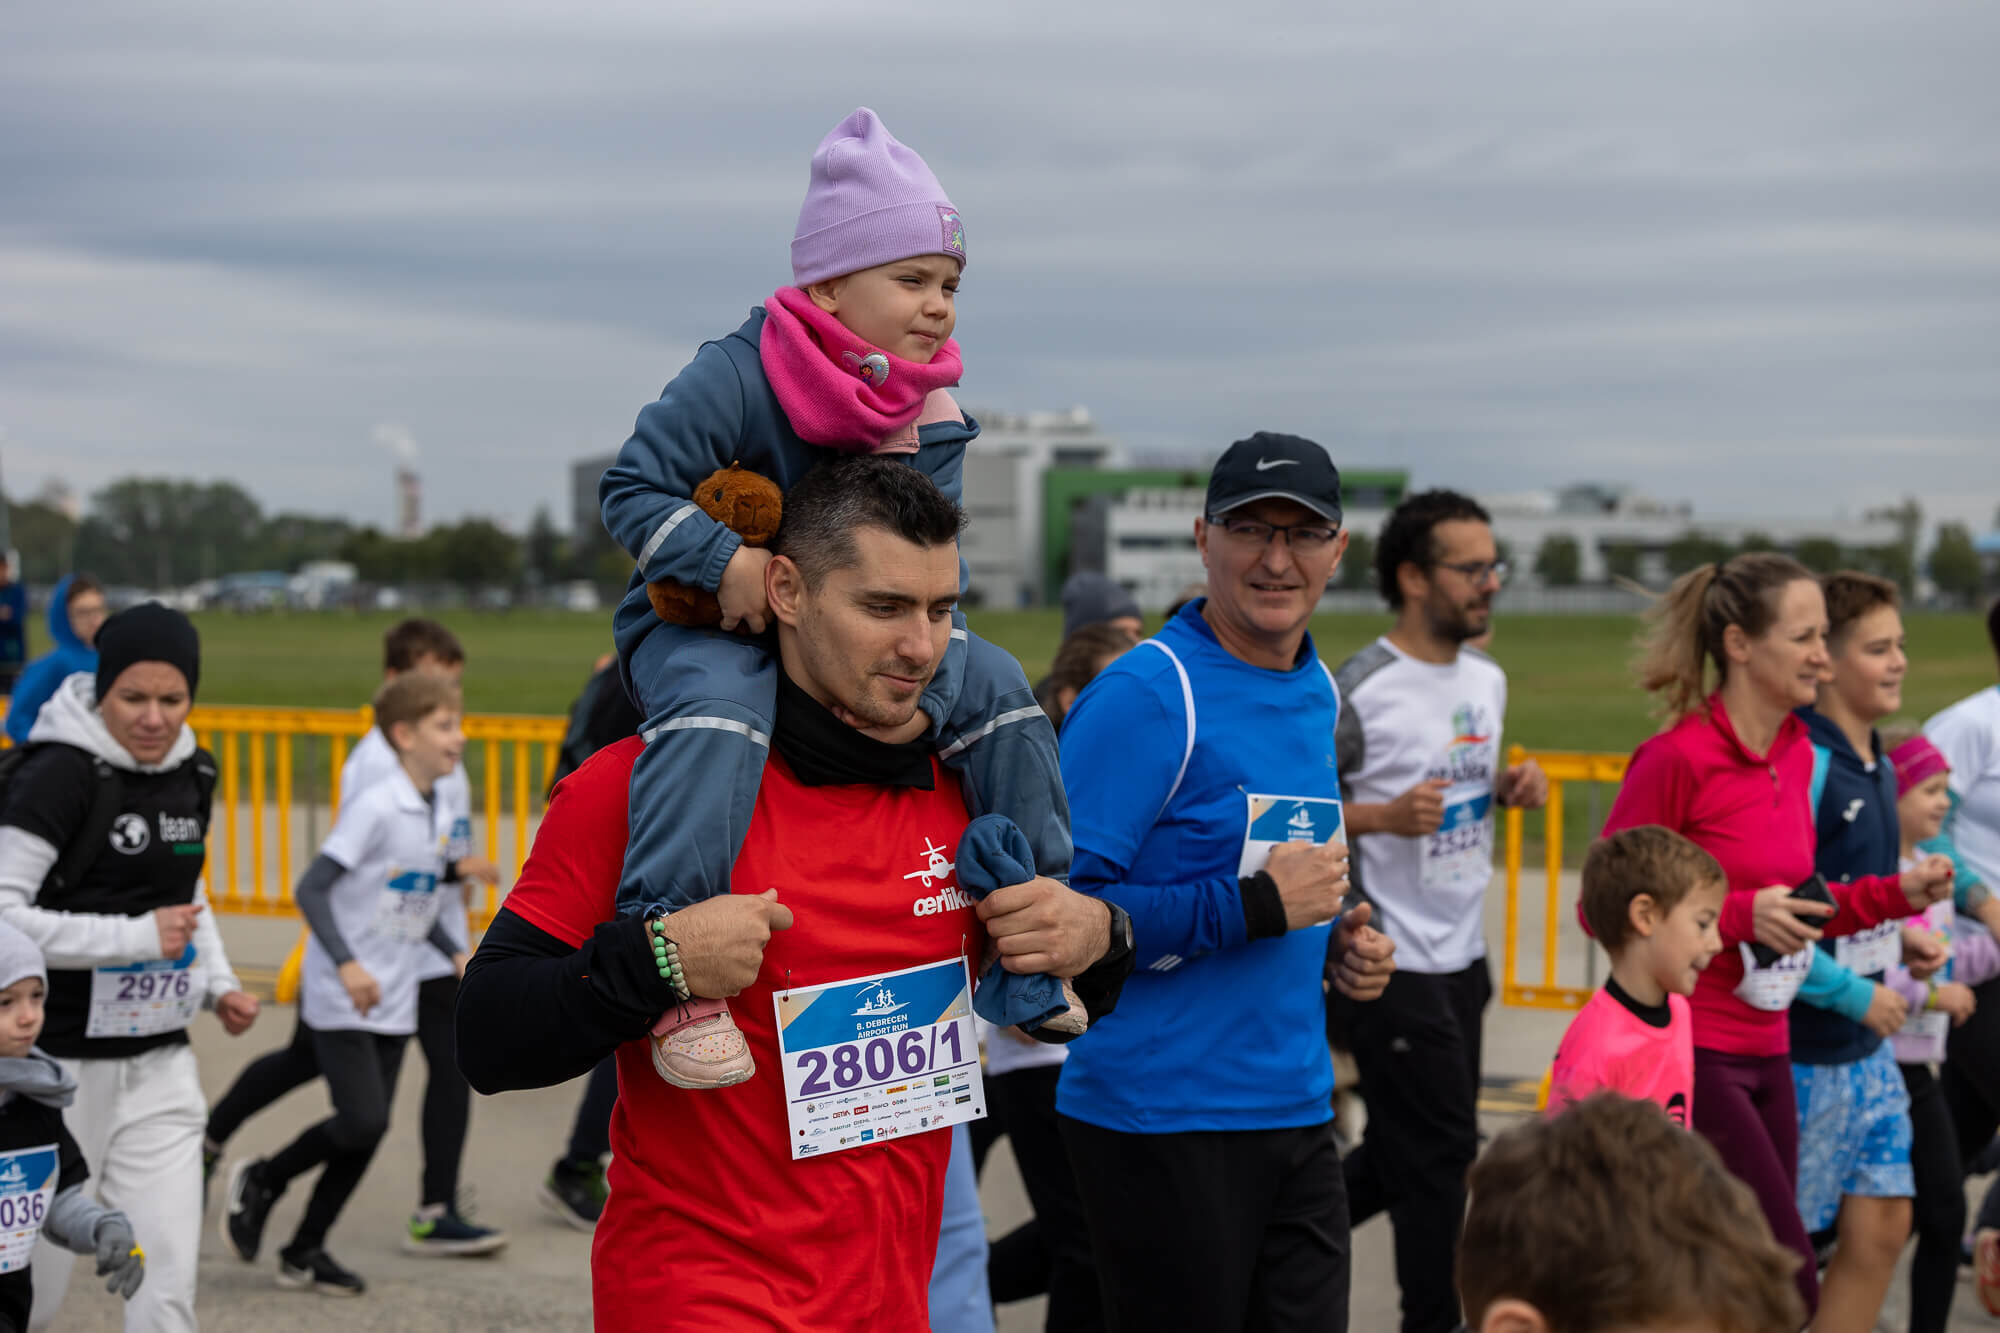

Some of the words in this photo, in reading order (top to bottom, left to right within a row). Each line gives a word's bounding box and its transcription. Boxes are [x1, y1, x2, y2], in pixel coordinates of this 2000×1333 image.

[159, 810, 201, 842] team
[116, 971, 191, 1001] 2976
[857, 1027, 890, 1040] AIRPORT
[892, 1022, 909, 1033] RUN
[866, 1014, 908, 1028] DEBRECEN
[797, 1020, 962, 1097] 2806/1
